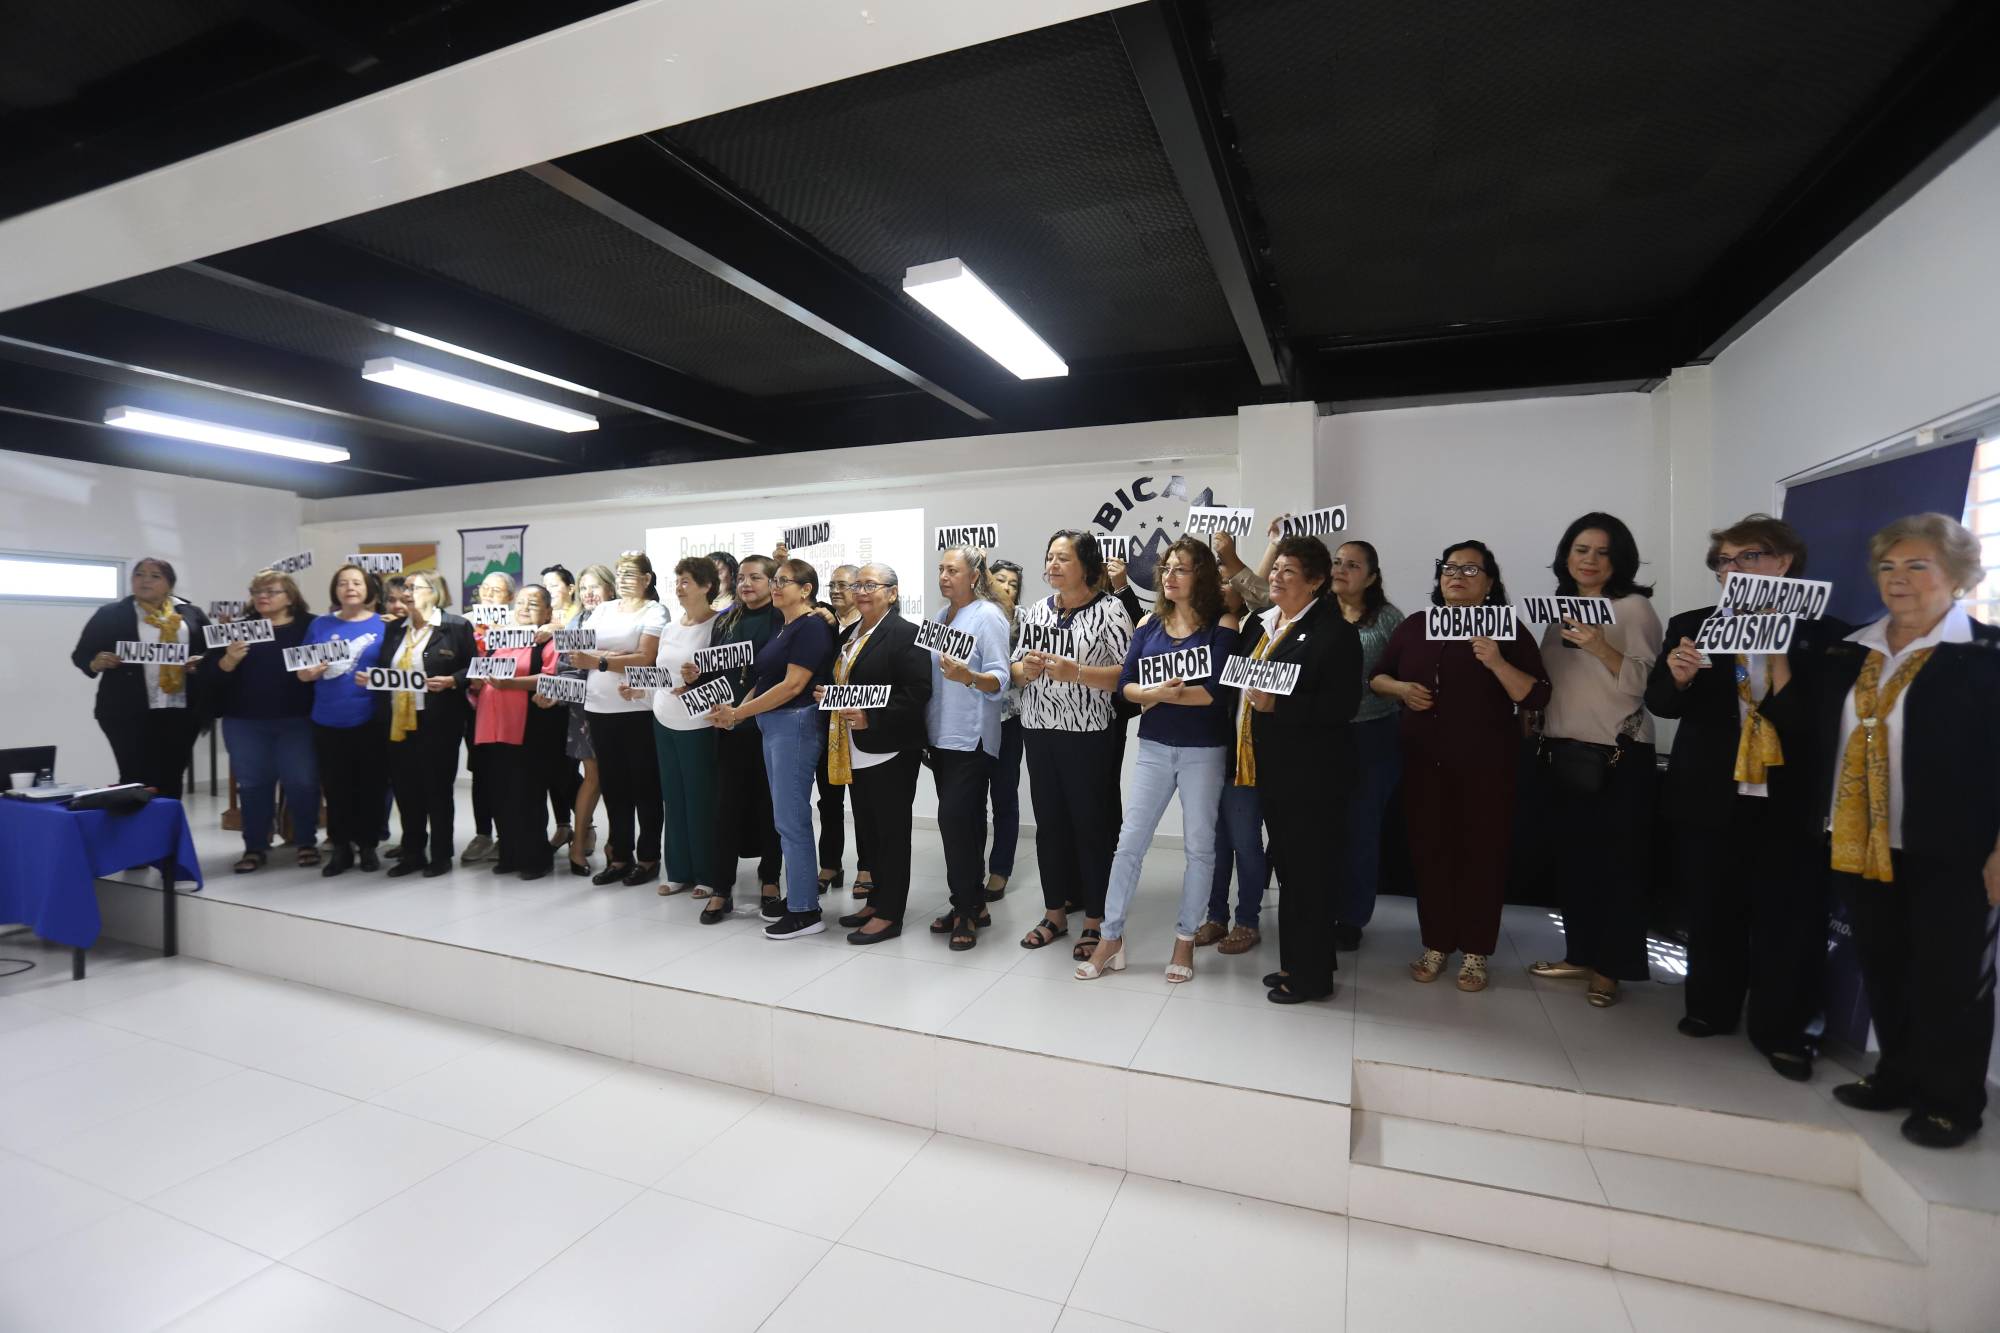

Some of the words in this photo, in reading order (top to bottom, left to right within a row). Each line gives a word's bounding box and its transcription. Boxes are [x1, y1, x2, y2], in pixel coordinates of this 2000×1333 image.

[784, 522, 830, 550] HUMILDAD
[1187, 511, 1251, 535] PERDÓN
[1283, 508, 1345, 537] ANIMO
[938, 527, 996, 550] AMISTAD
[1525, 597, 1612, 624] VALENTIA
[1723, 576, 1825, 620] SOLIDARIDAD
[475, 607, 508, 625] AMOR
[1429, 607, 1514, 637] COBARDIA
[207, 620, 272, 645] IMPACIENCIA
[488, 630, 536, 649] GRATITUD
[917, 620, 974, 660] ENEMISTAD
[1022, 623, 1075, 658] APATIA
[1696, 615, 1791, 650] EGOISMO
[118, 642, 186, 663] INJUSTICIA
[694, 644, 752, 673] SINCERIDAD
[1141, 648, 1209, 685] RENCOR
[370, 668, 425, 689] ODIO
[470, 658, 515, 676] INGRATITUD
[1223, 655, 1297, 692] INDIFERENCIA
[682, 681, 732, 716] FALSEDAD
[822, 686, 888, 707] ARROGANCIA
